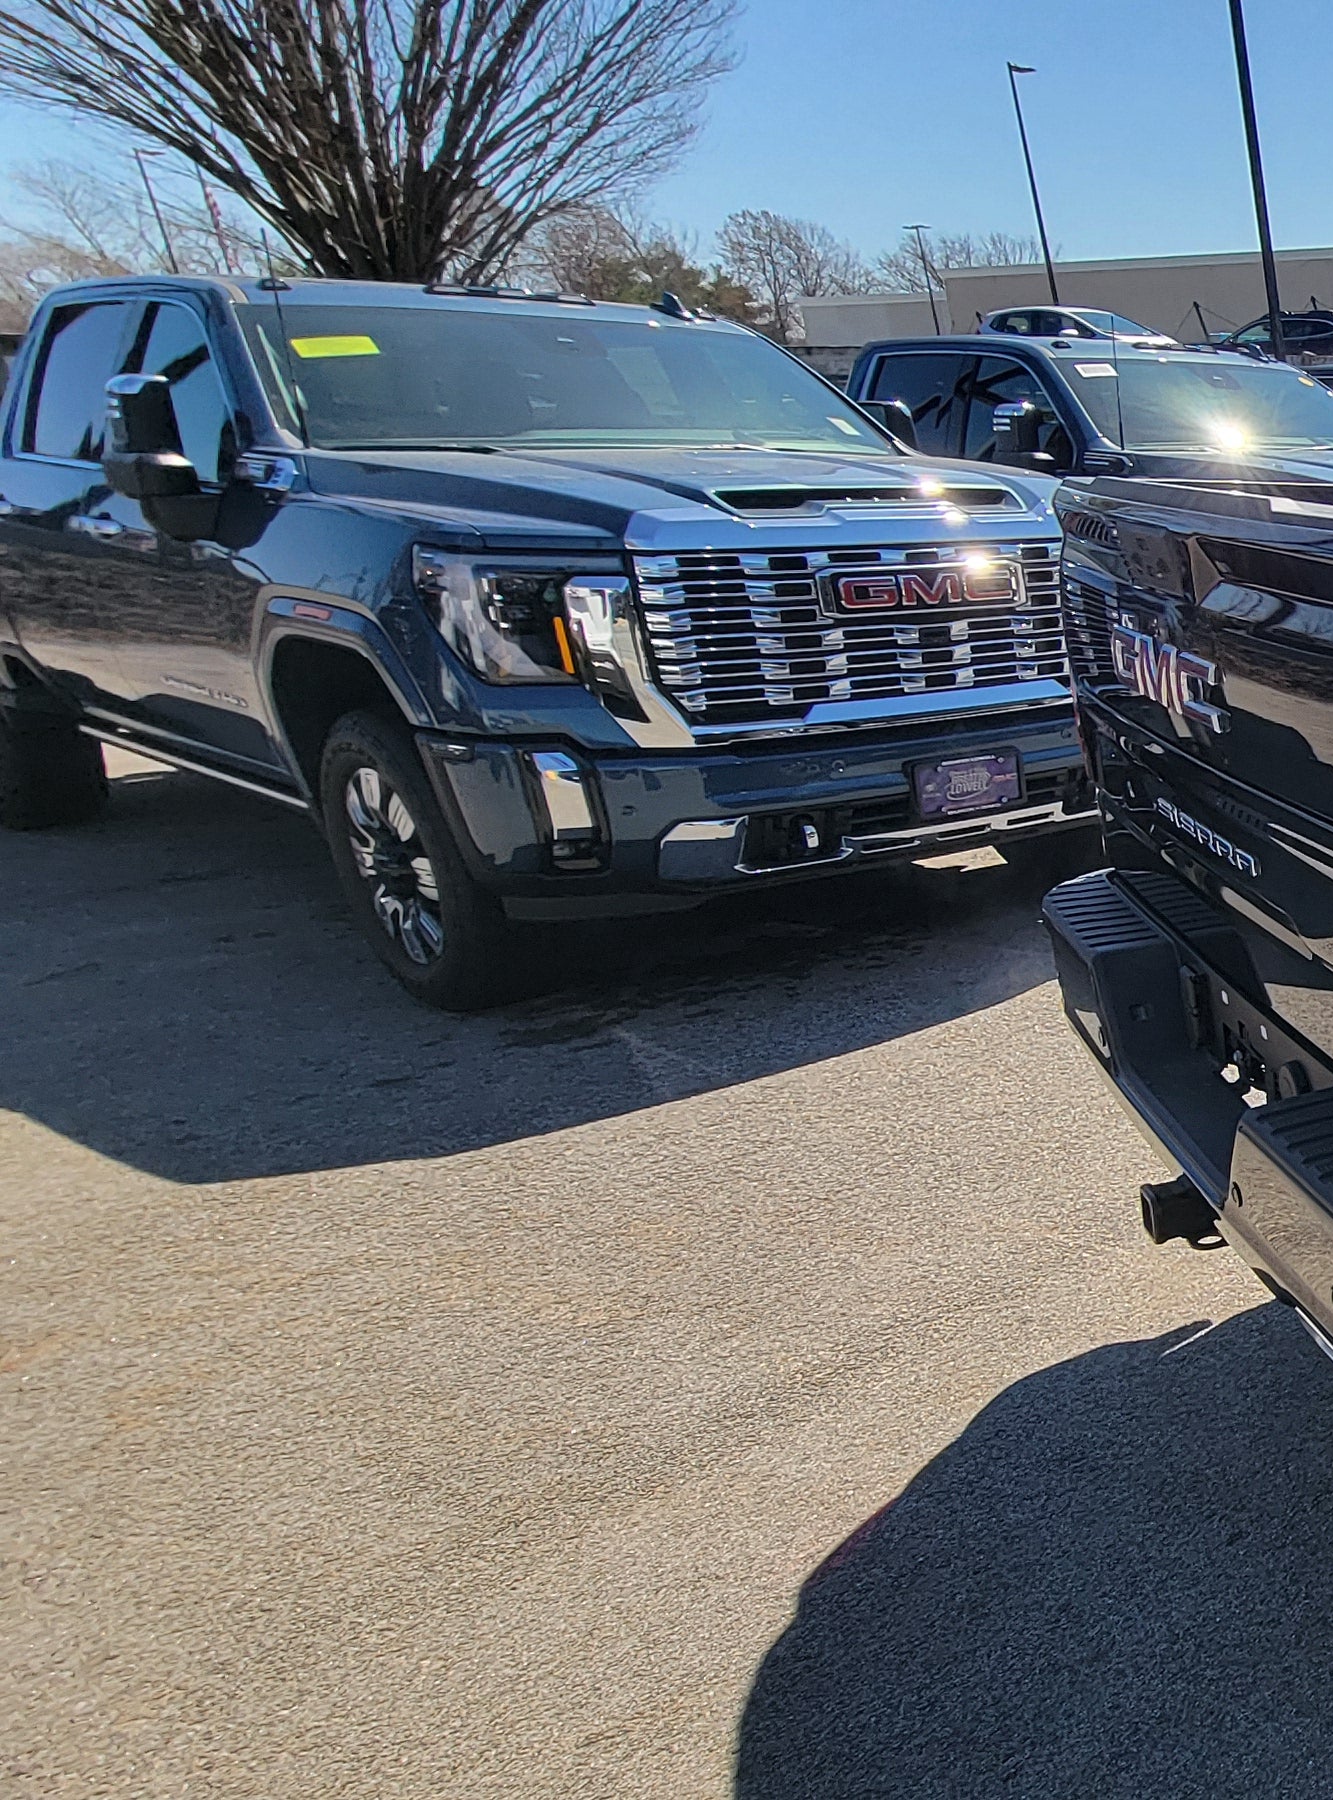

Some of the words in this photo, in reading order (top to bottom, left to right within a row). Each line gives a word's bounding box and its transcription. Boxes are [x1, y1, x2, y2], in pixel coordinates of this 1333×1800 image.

[839, 570, 1014, 609] GMC
[1111, 624, 1225, 734] GMC
[1158, 797, 1258, 878] SIERRA
